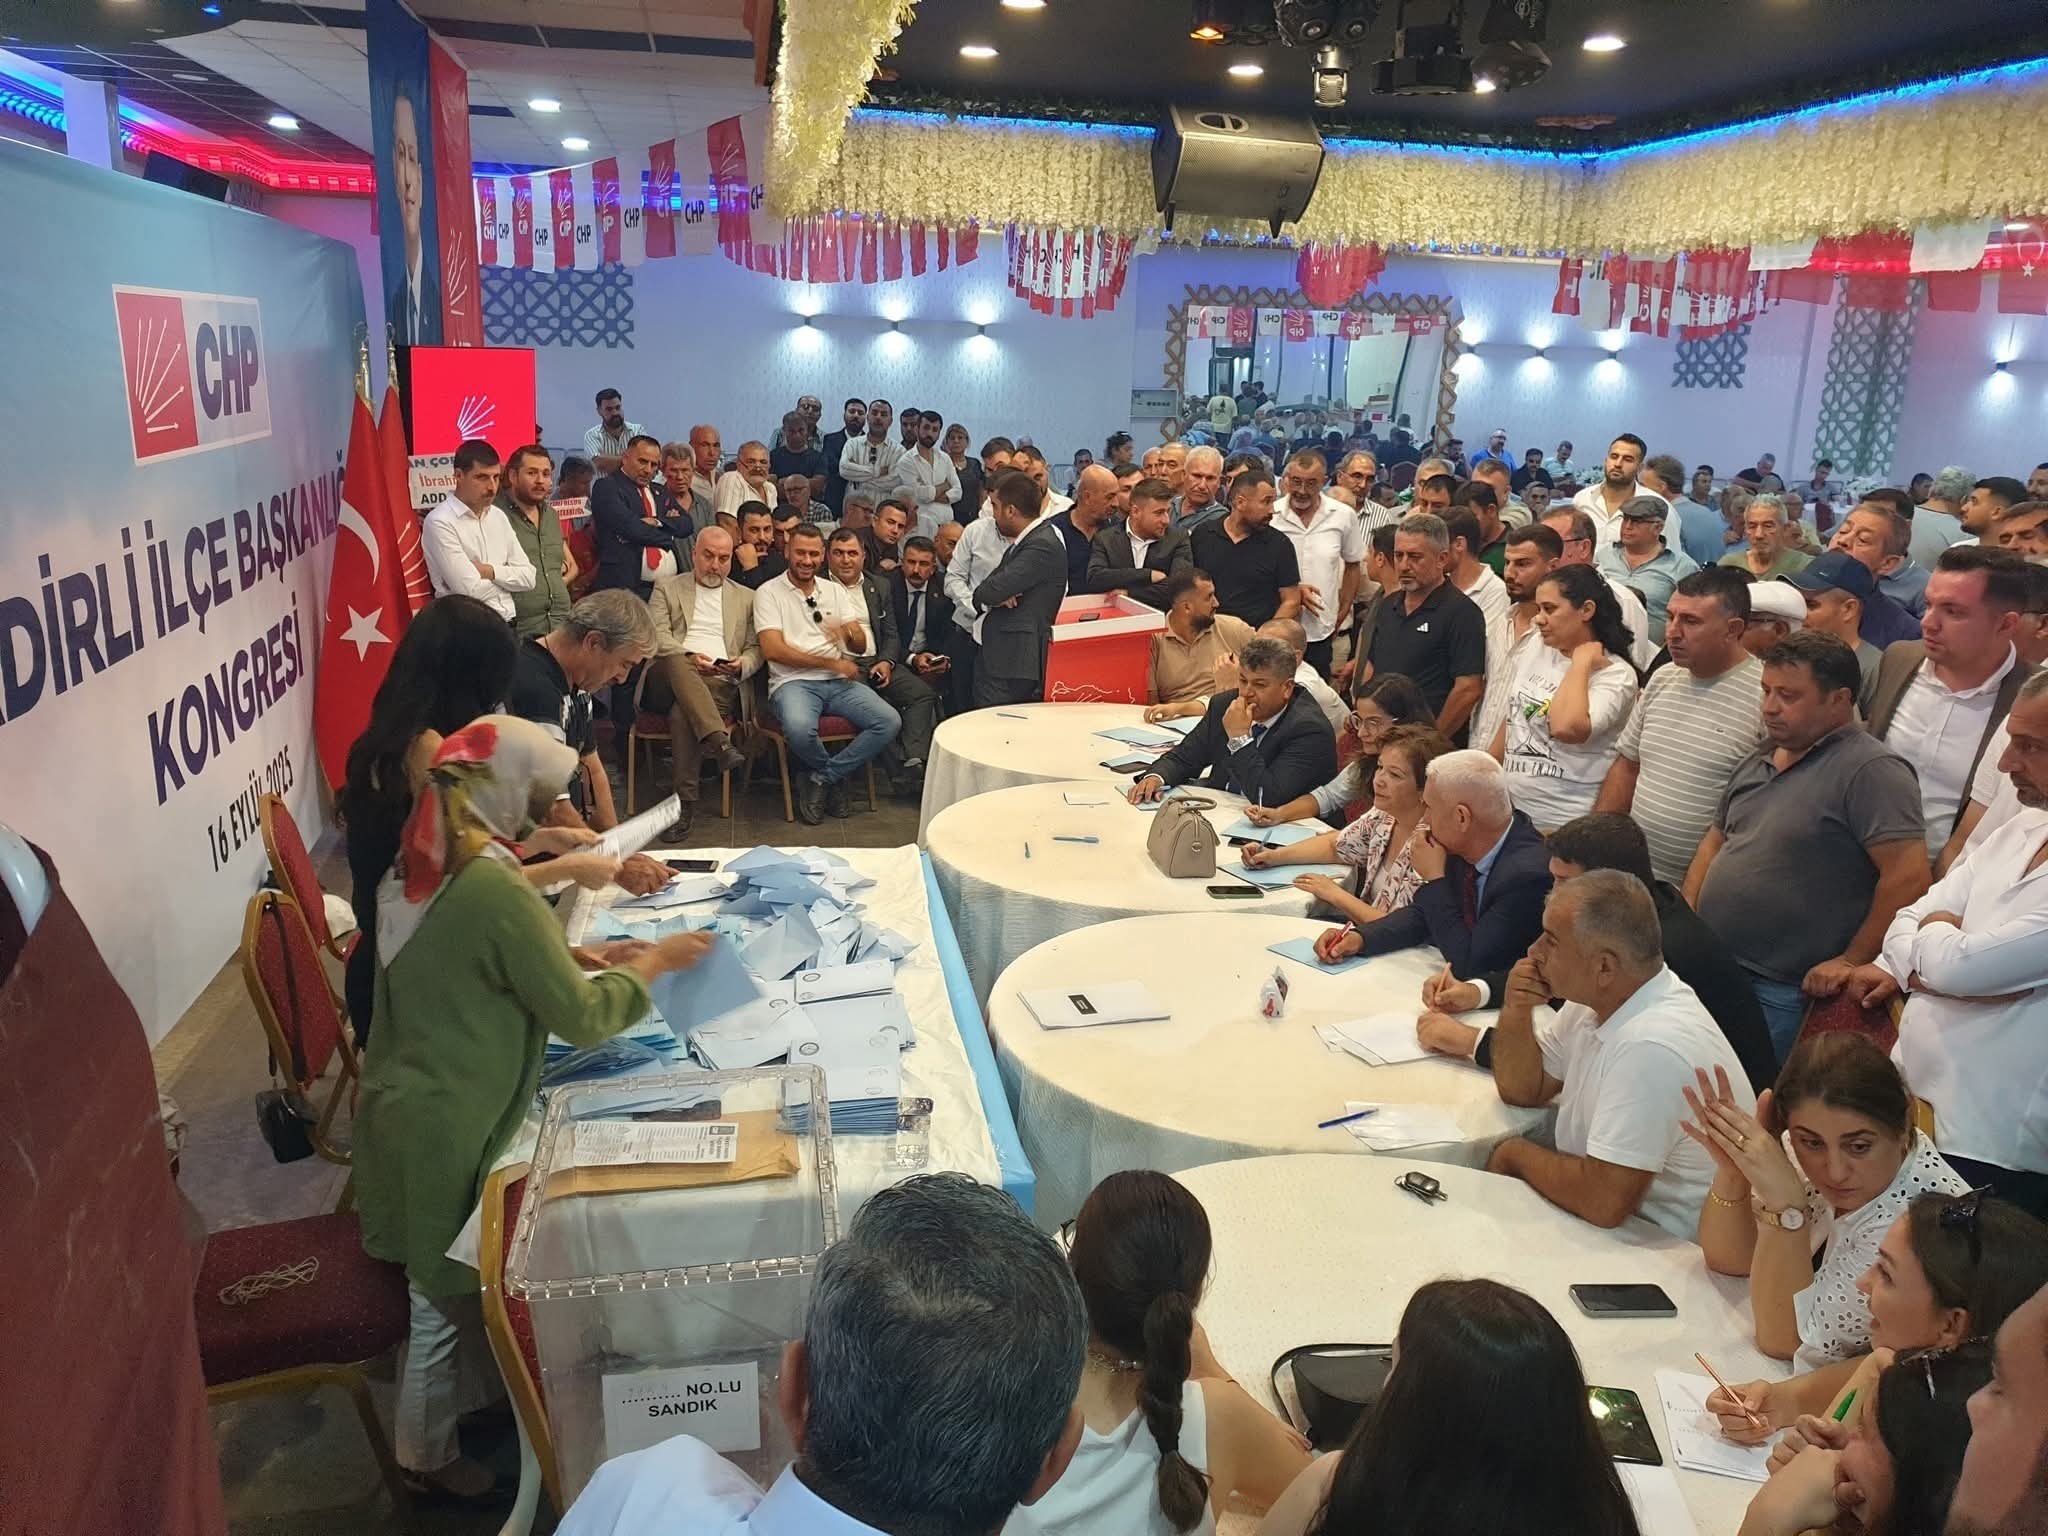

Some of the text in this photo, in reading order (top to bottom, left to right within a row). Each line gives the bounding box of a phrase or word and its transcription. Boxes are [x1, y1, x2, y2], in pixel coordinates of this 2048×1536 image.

[719, 184, 740, 206] HP
[751, 183, 764, 210] CH
[624, 207, 641, 229] CHP
[685, 200, 705, 225] CHP
[498, 223, 510, 240] CHP
[534, 227, 549, 247] CHP
[576, 224, 592, 245] CHP
[195, 322, 260, 421] CHP
[0, 526, 145, 727] DİRLİ
[144, 519, 233, 639] İLÇE
[147, 591, 305, 807] KONGRESİ
[208, 815, 230, 874] 16
[266, 745, 295, 799] 2025
[686, 1380, 742, 1397] NO.LU
[648, 1399, 718, 1417] SANDIK
